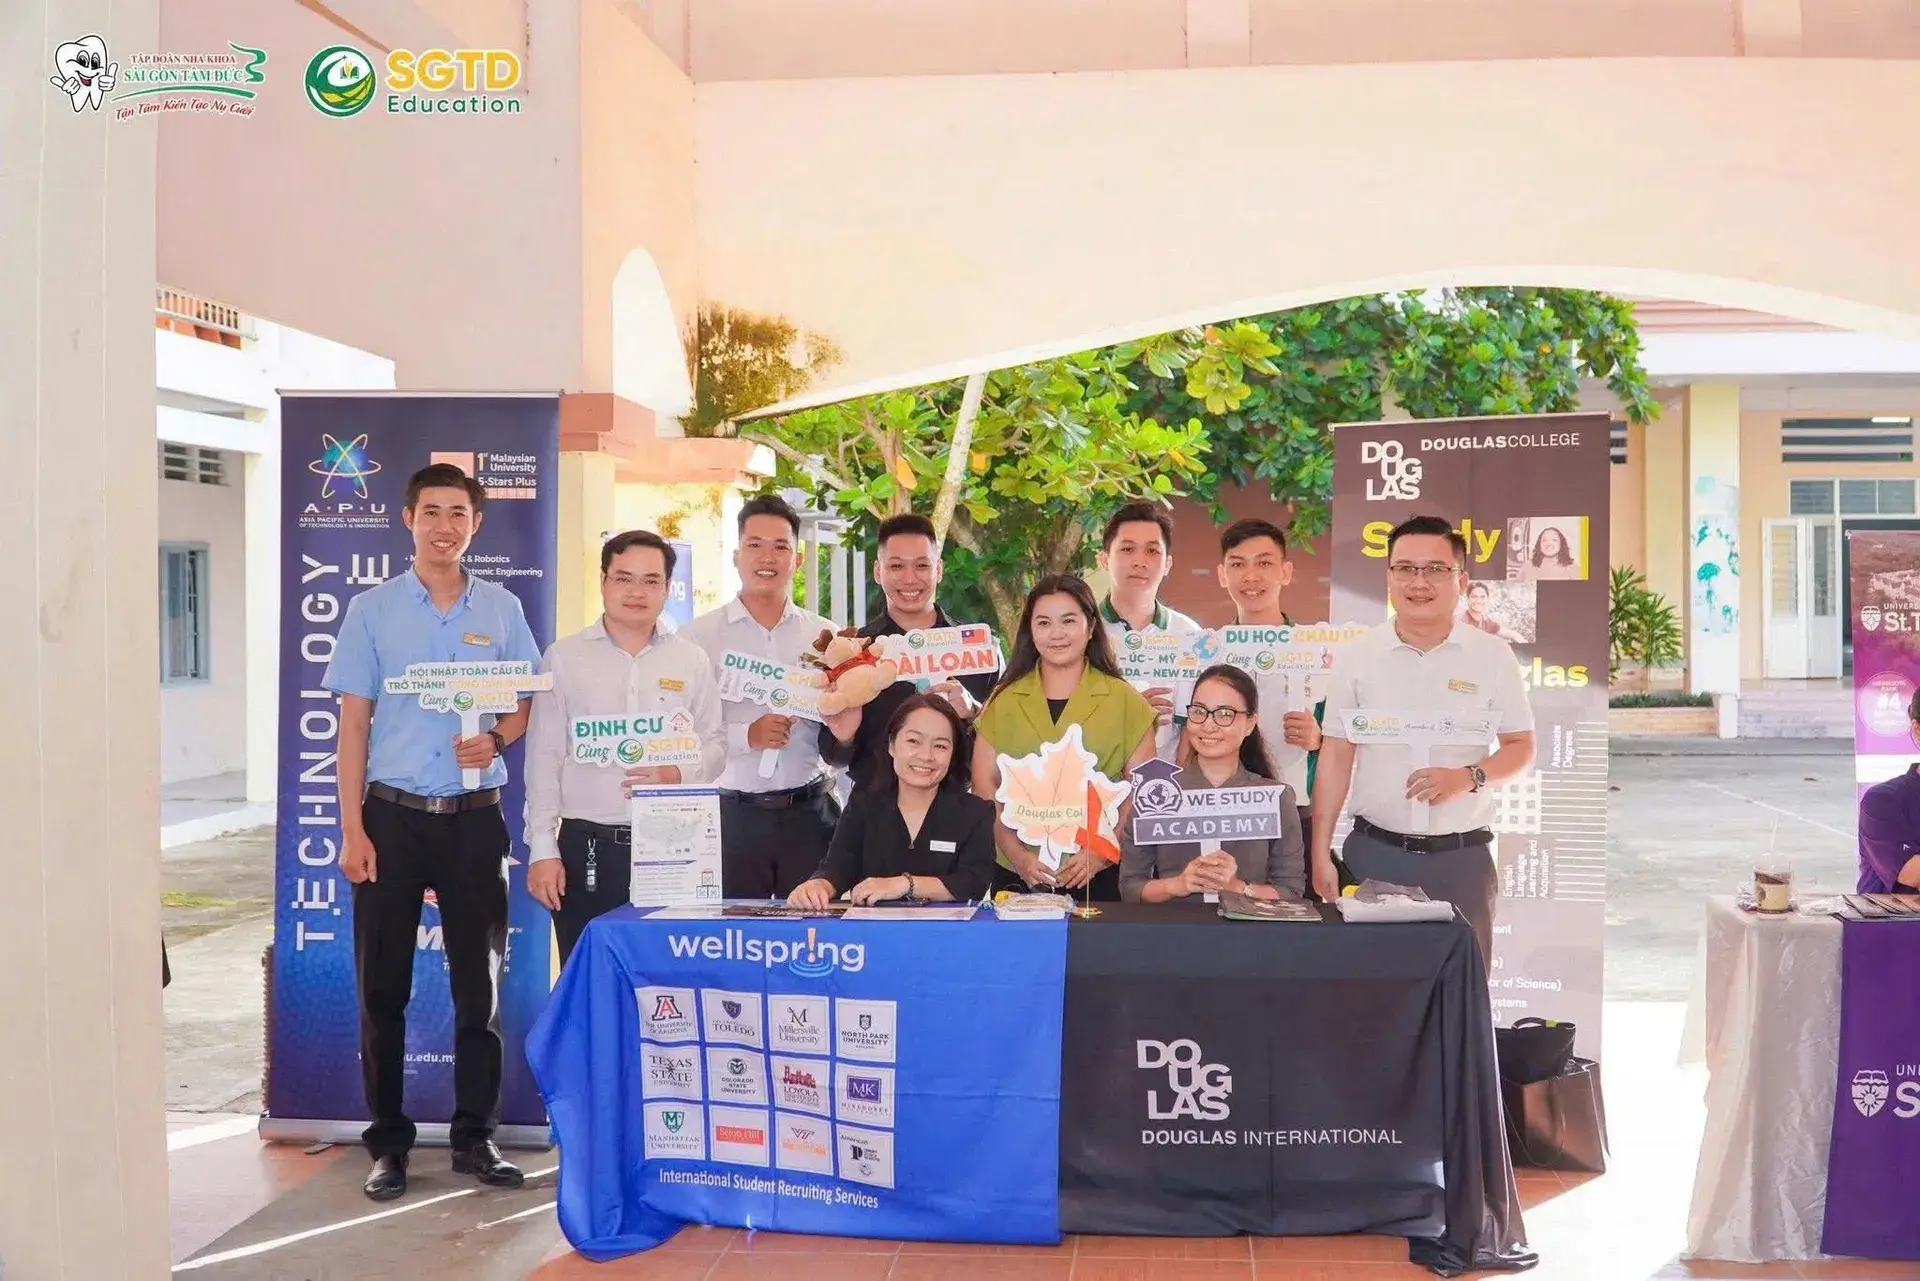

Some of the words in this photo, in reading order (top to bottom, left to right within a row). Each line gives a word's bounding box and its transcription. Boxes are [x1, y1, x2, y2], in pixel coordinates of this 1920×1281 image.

[490, 453, 536, 463] Malaysian
[490, 463, 537, 473] University
[516, 477, 537, 486] Plus
[467, 555, 473, 563] &
[474, 555, 510, 563] Robotics
[495, 567, 543, 577] Engineering
[1226, 630, 1249, 643] DU
[1253, 629, 1290, 647] HỌC
[927, 649, 994, 673] LOAN
[1129, 652, 1145, 663] ÚC
[724, 654, 747, 669] DU
[749, 661, 785, 680] HỌC
[1153, 668, 1180, 678] NEW
[789, 704, 819, 716] Educatio
[576, 720, 627, 741] ĐỊNH
[633, 715, 664, 734] CƯ
[648, 753, 698, 762] Education
[1187, 794, 1216, 806] WE
[1220, 790, 1276, 806] STUDY
[1017, 805, 1062, 821] Douglas
[1152, 817, 1269, 836] ACADEMY
[1503, 977, 1513, 987] of
[1516, 977, 1562, 991] Science)
[713, 1023, 755, 1037] TOLEDO
[779, 1025, 820, 1035] Millersville
[841, 1030, 867, 1039] NORTH
[779, 1033, 820, 1045] University
[843, 1037, 888, 1046] UNIVERSITY
[649, 1055, 693, 1068] TEXAS
[651, 1070, 693, 1082] STATE
[784, 1086, 819, 1098] LOYOLA
[1141, 1129, 1237, 1146] DOUGLAS
[1244, 1129, 1402, 1147] INTERNATIONAL
[651, 1142, 699, 1150] UNIVERSITY
[659, 1169, 731, 1188] International
[733, 1174, 775, 1193] Student
[778, 1180, 832, 1205] Recruiting
[834, 1187, 879, 1208] Services
